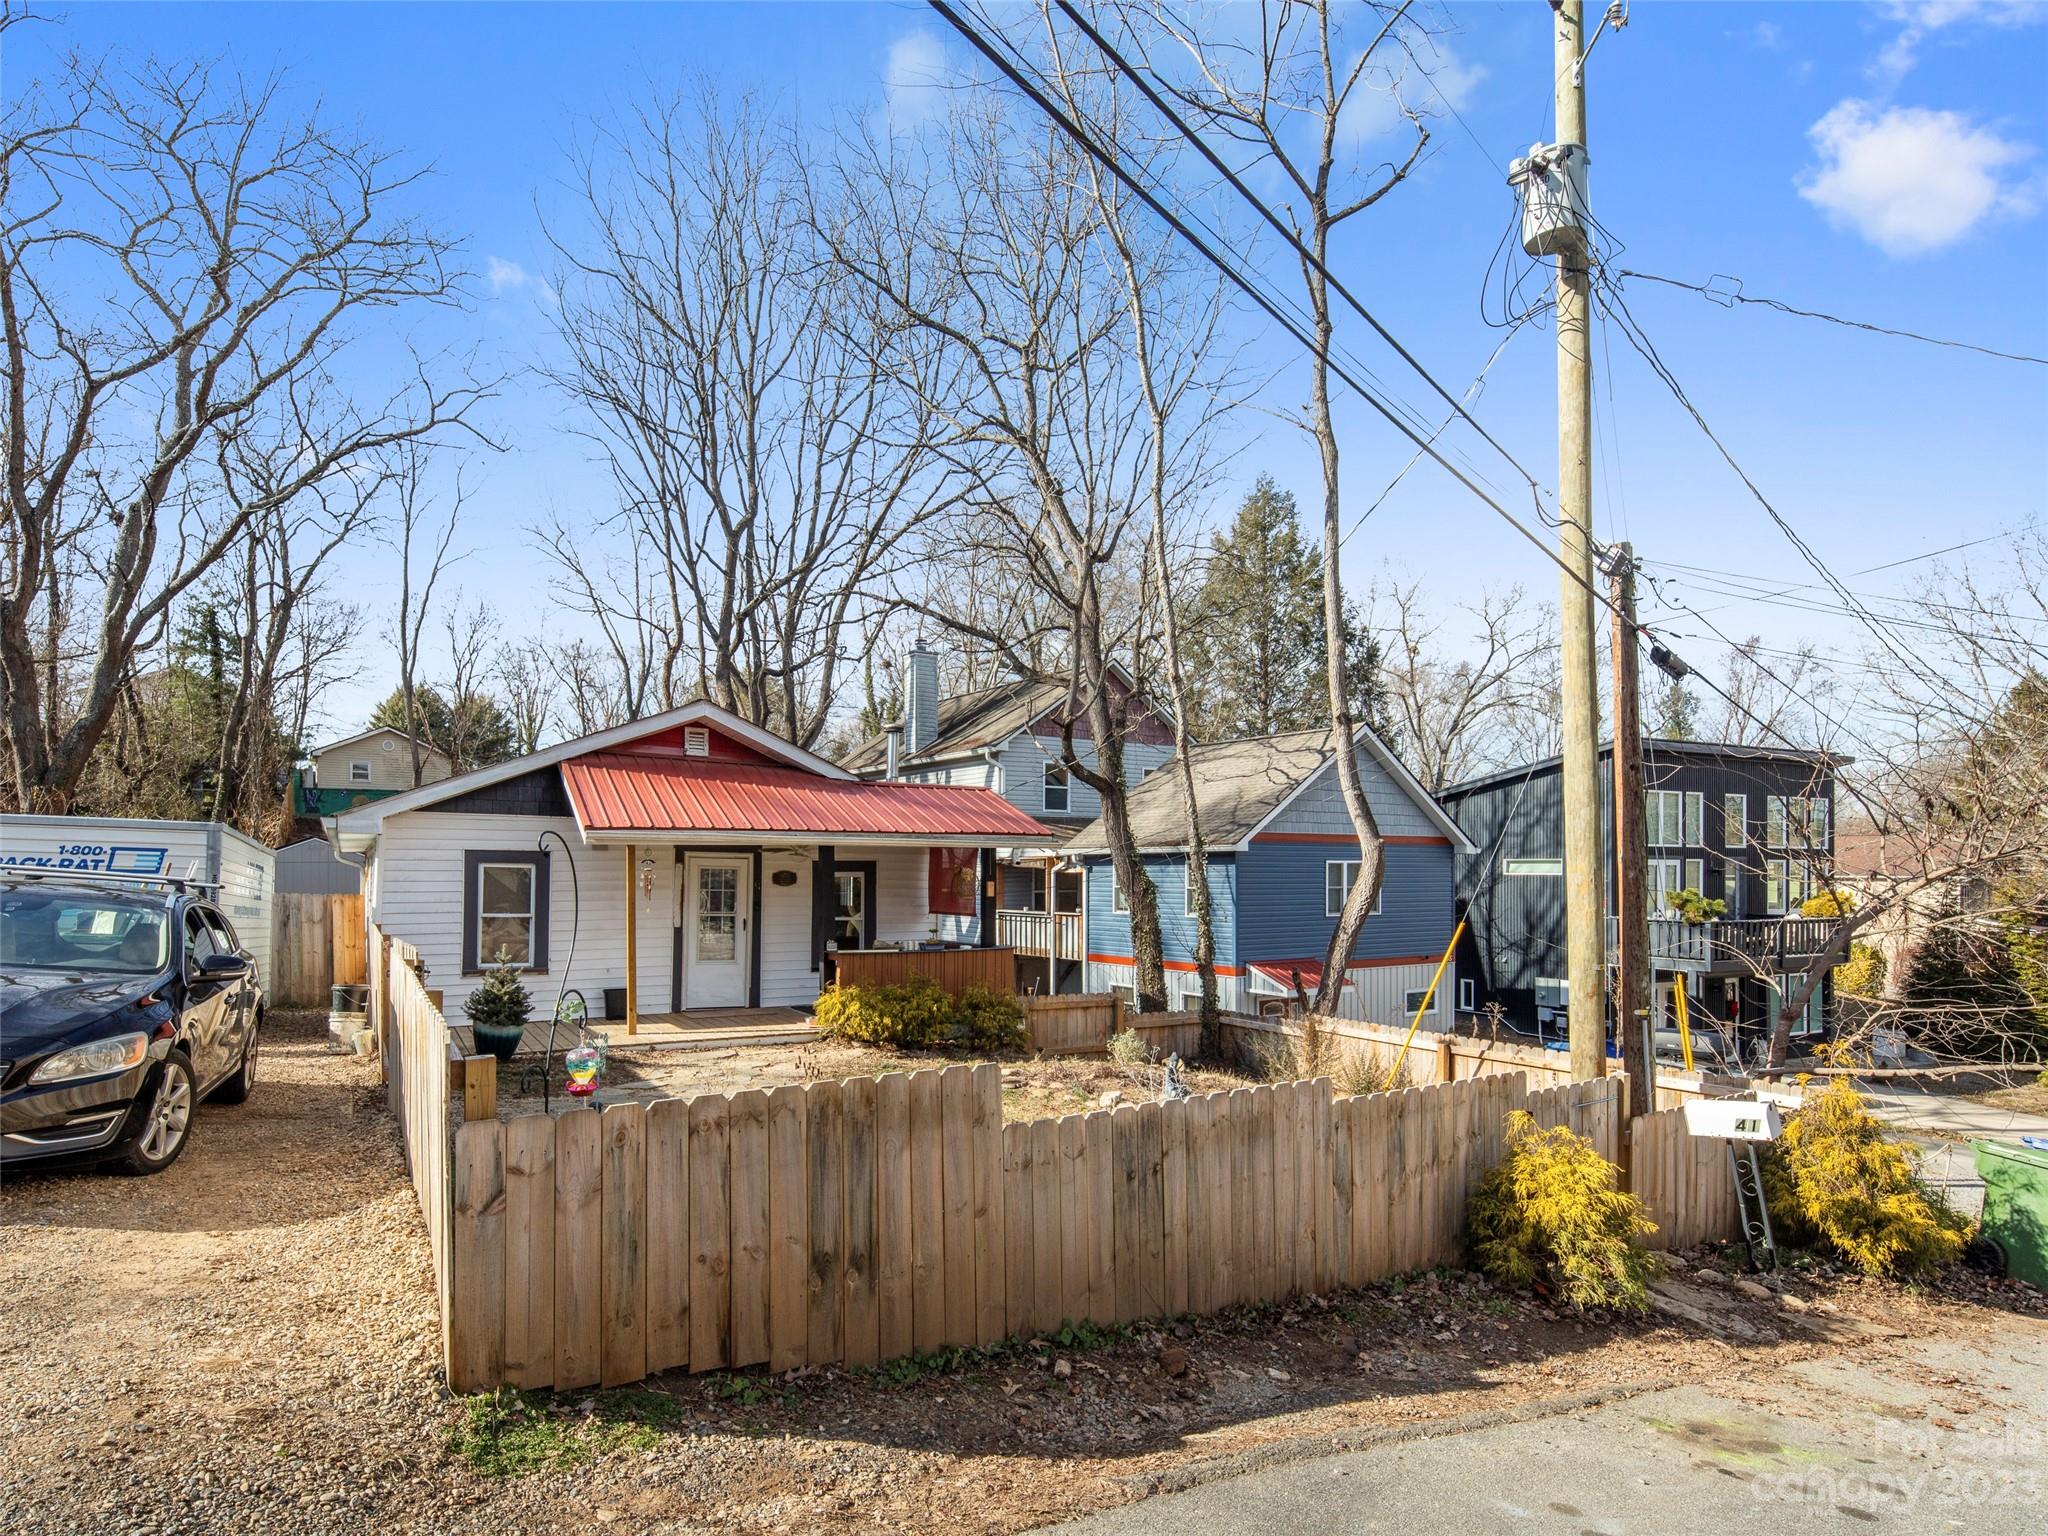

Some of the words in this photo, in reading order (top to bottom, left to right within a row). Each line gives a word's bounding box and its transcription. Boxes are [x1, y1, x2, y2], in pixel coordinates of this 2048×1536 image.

[59, 845, 107, 856] 1-800-
[0, 857, 105, 871] ACK-RAT
[1736, 1119, 1757, 1132] 41
